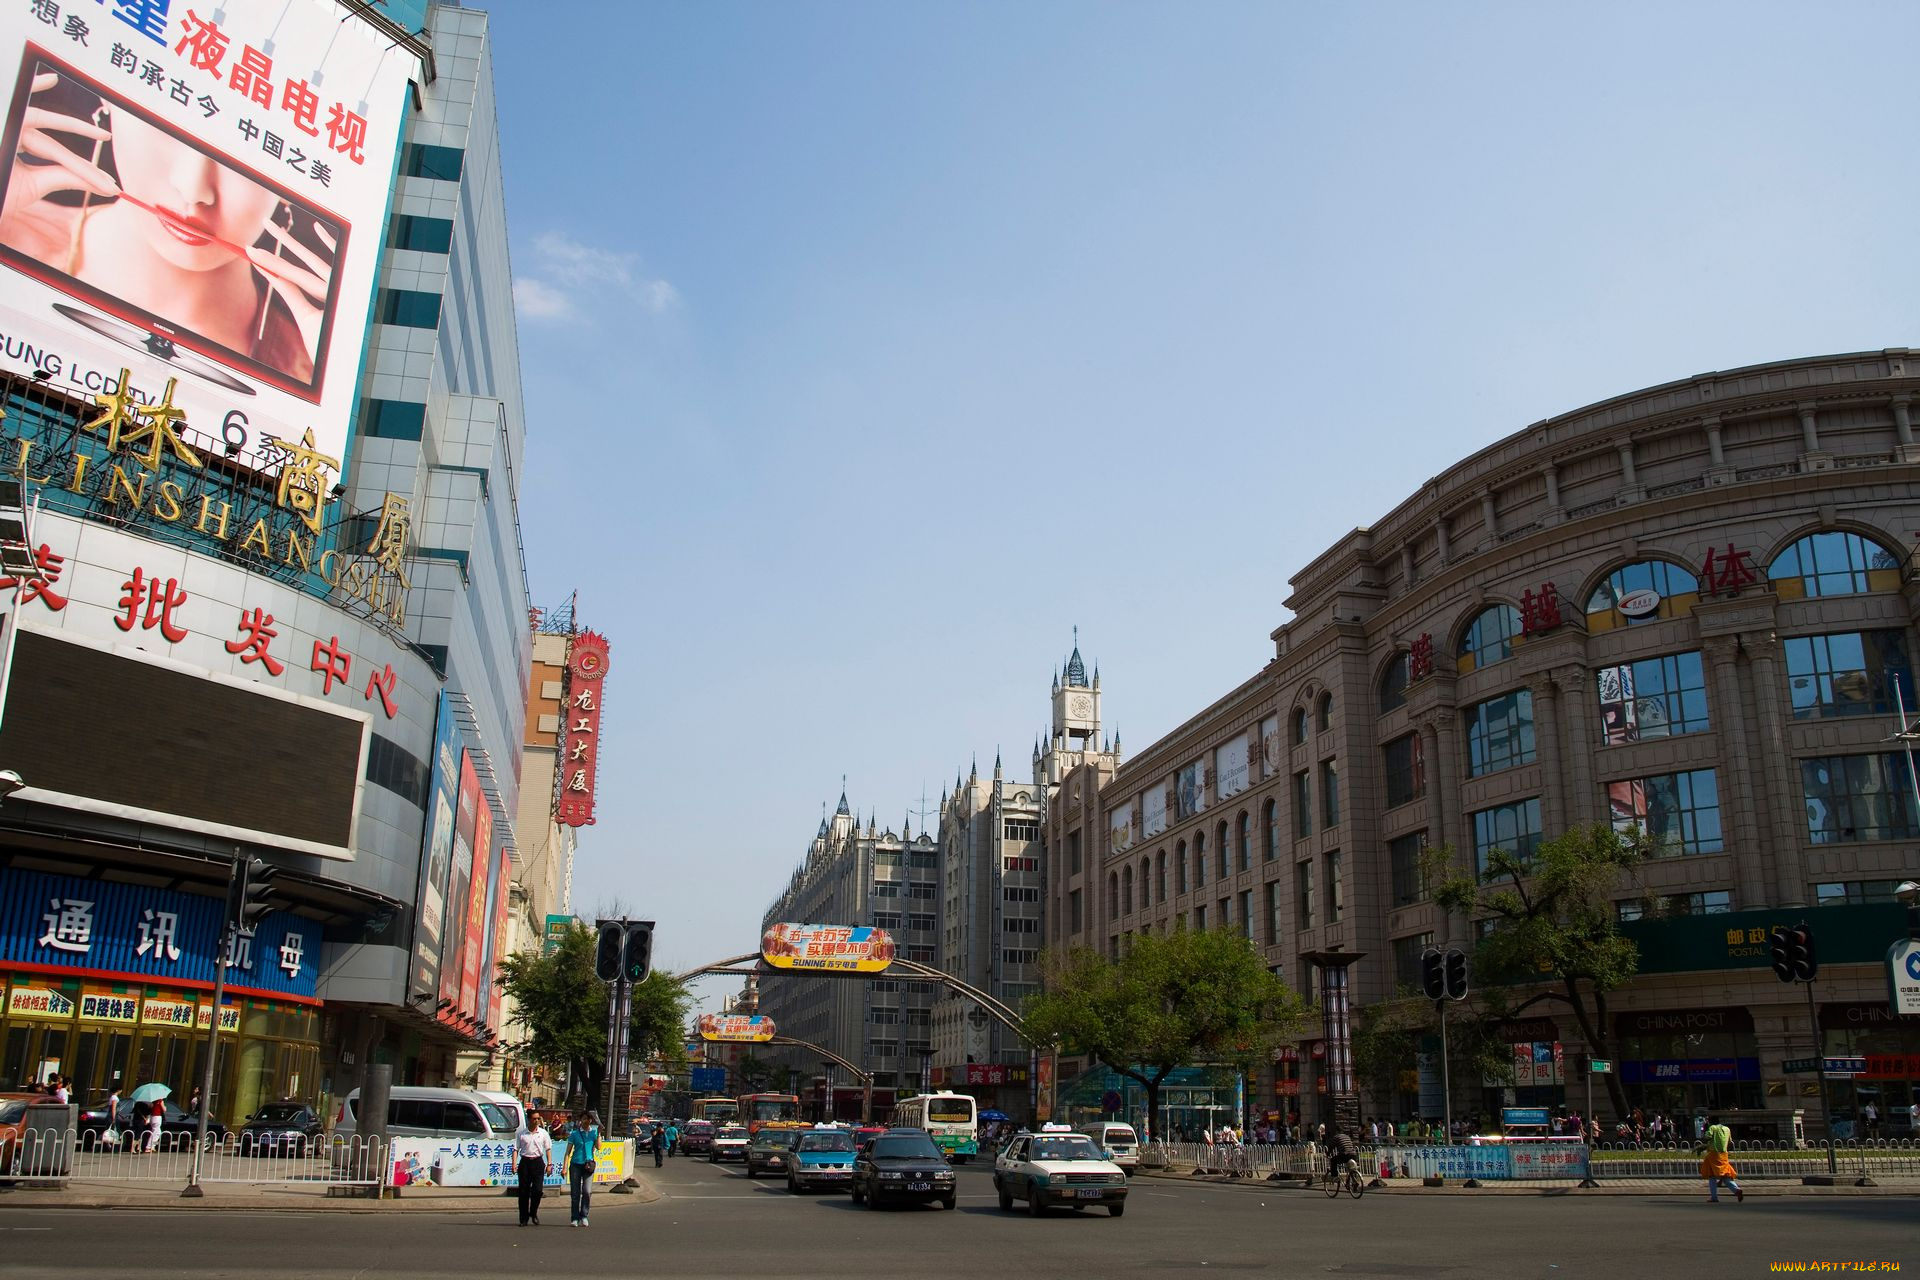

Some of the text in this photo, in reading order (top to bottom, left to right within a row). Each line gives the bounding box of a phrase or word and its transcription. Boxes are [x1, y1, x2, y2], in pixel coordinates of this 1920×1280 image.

[97, 0, 369, 166] 星液晶电视
[110, 42, 221, 119] 韵承古今
[237, 118, 332, 188] 中国之美
[222, 410, 249, 448] 6
[0, 367, 412, 590] 林商厦
[566, 688, 596, 793] 龙工大厦
[789, 928, 852, 943] 五一来苏宁
[792, 958, 826, 968] SUNING
[82, 997, 136, 1019] 四楼快餐
[1637, 1012, 1725, 1030] CHINA POST
[970, 1071, 1002, 1084] 宾馆
[1656, 1064, 1681, 1077] EMS
